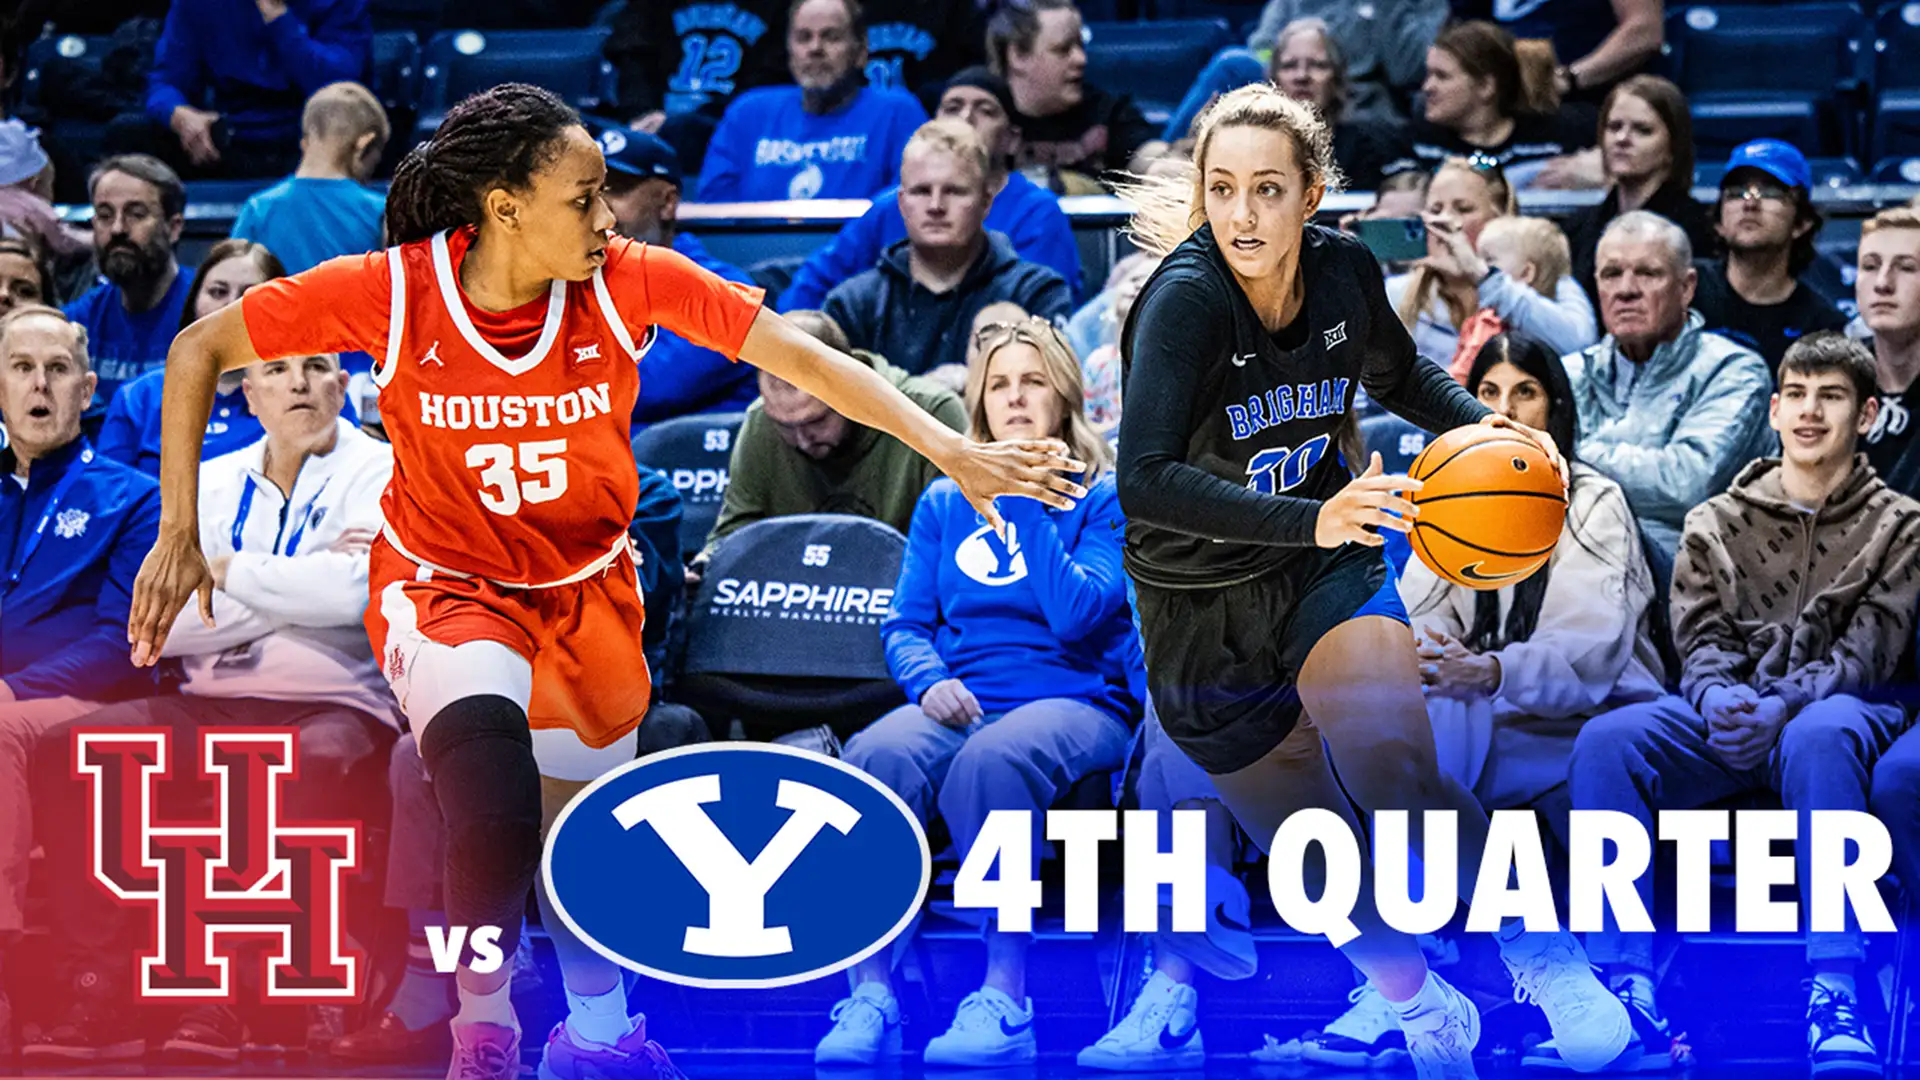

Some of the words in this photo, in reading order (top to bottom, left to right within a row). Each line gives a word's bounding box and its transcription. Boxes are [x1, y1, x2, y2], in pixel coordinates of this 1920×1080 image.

[668, 33, 743, 94] 12
[418, 382, 611, 430] HOUSTON
[1226, 377, 1349, 440] BRIGHAM
[704, 429, 730, 451] 53
[465, 438, 568, 516] 35
[802, 544, 832, 567] 55
[710, 607, 771, 618] WEALTH
[713, 578, 895, 615] SAPPHIRE
